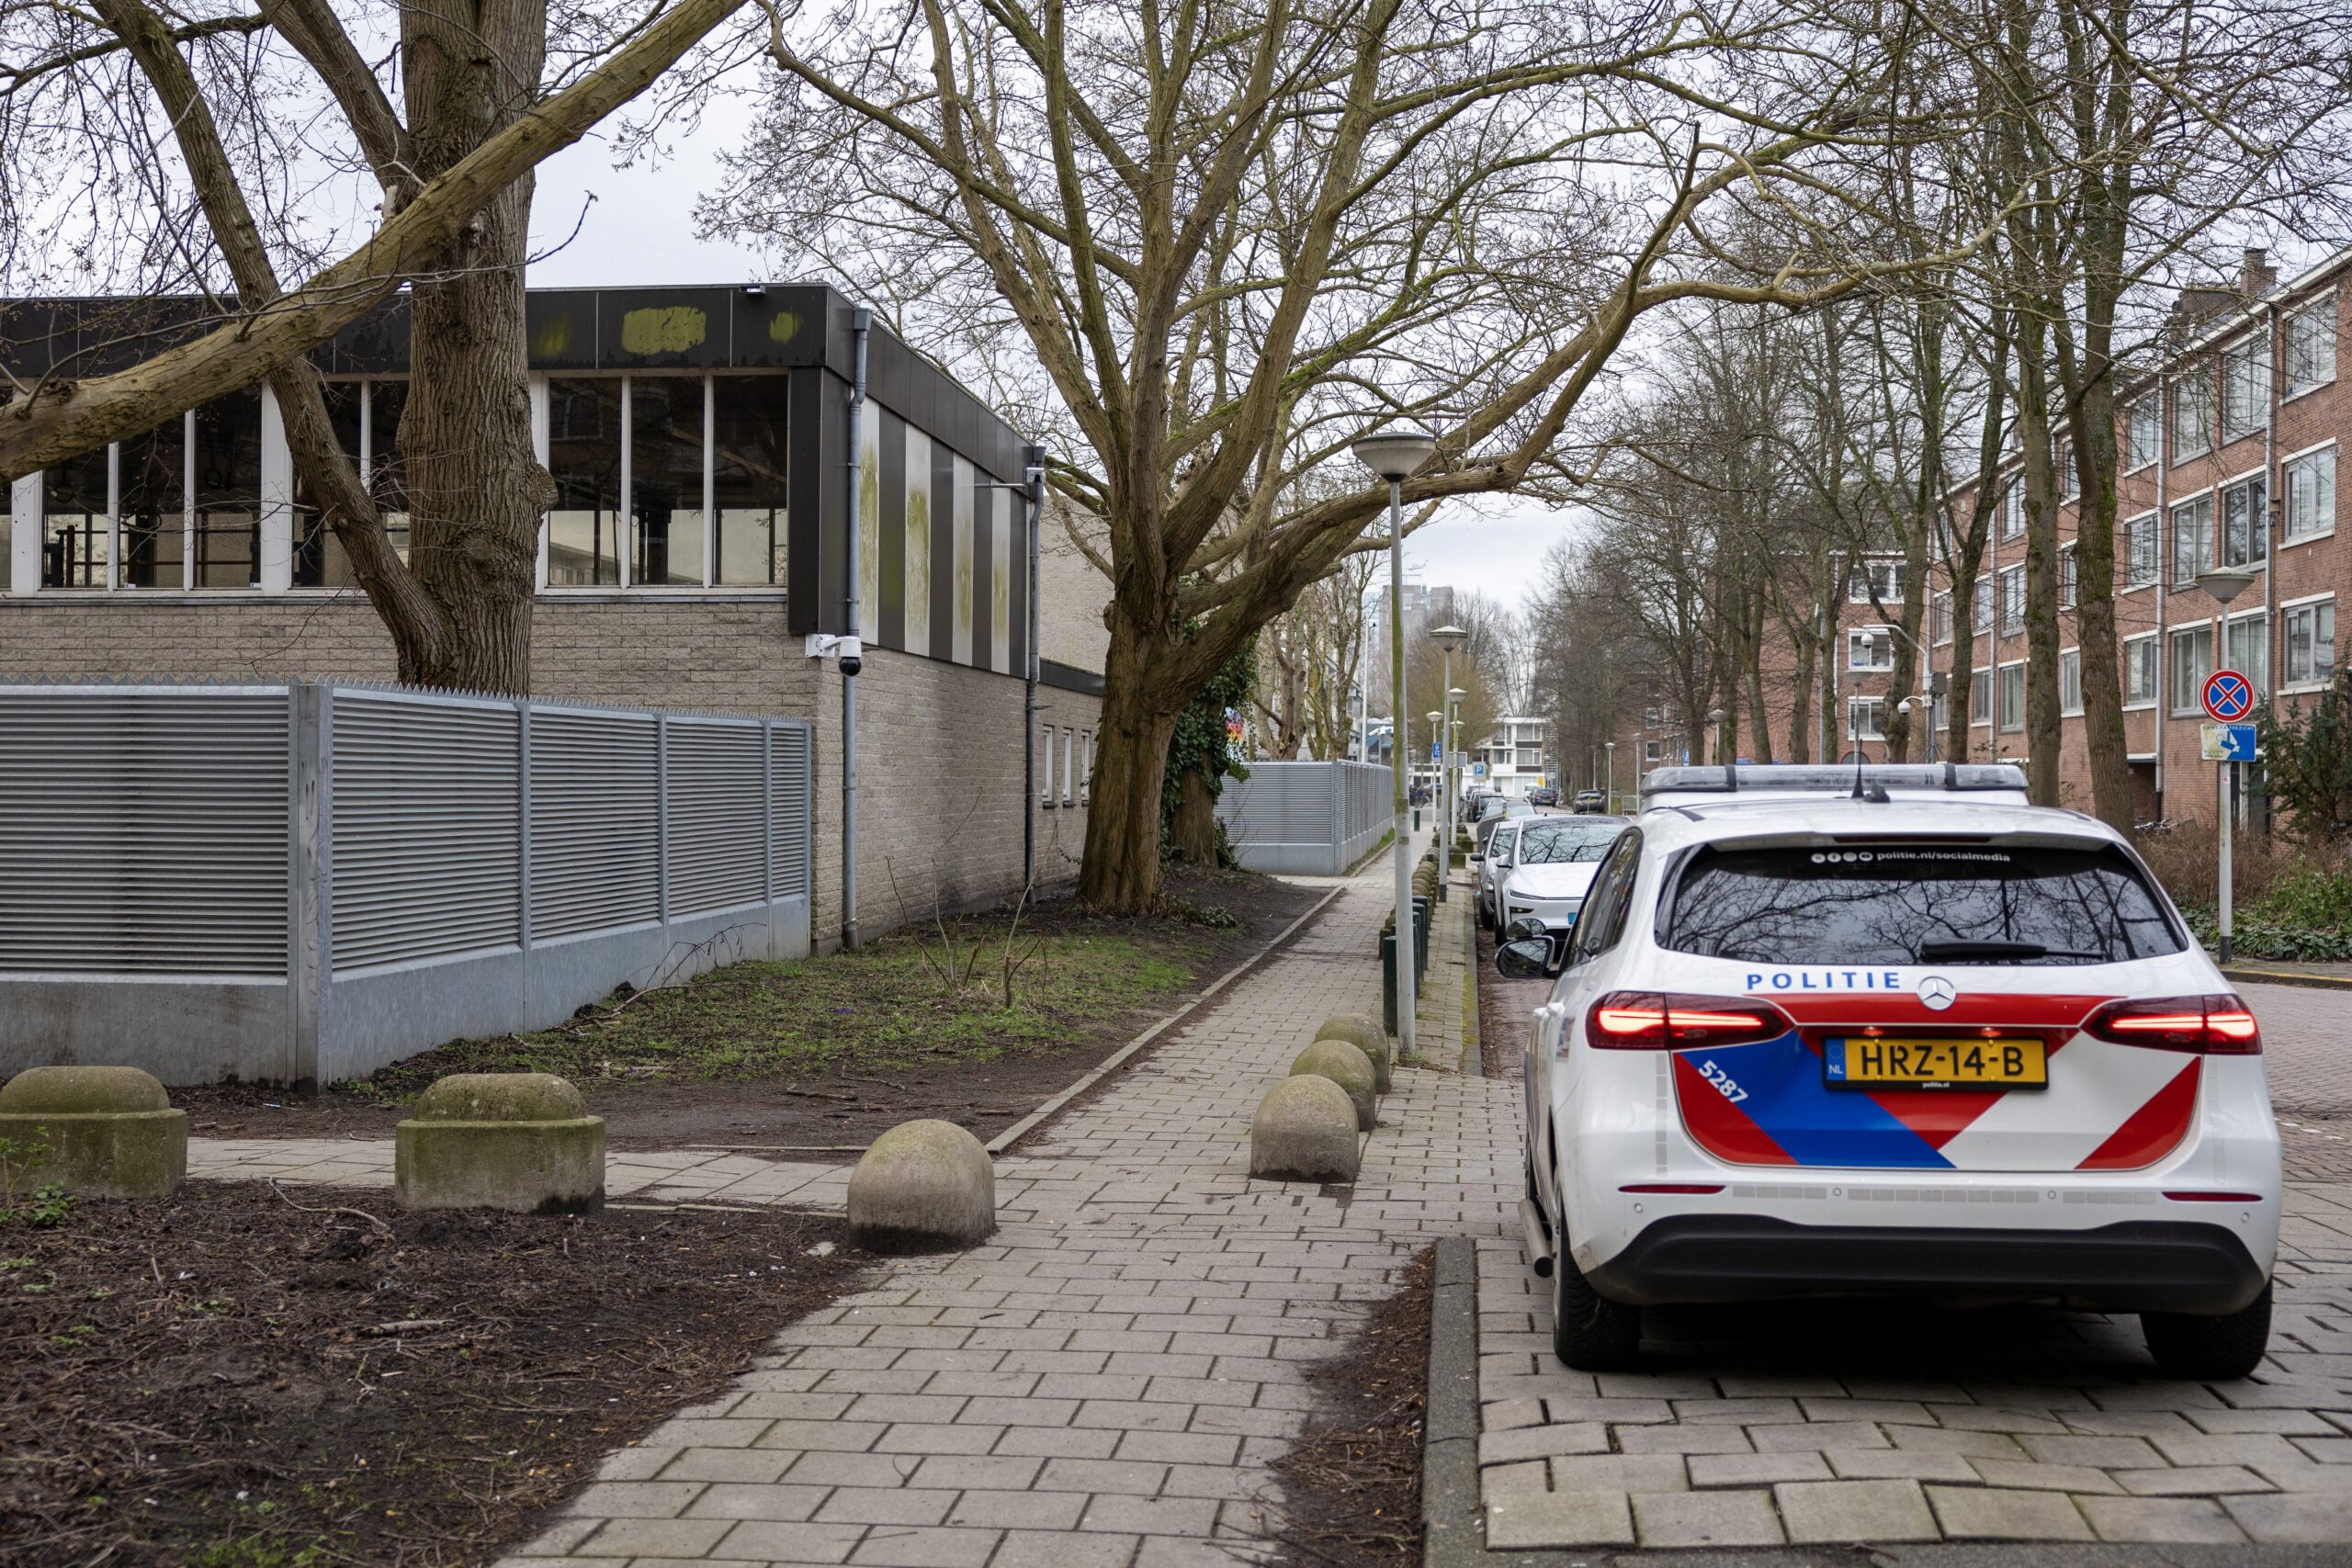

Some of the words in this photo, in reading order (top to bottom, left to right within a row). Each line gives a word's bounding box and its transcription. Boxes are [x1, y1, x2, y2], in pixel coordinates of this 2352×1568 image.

[1877, 852, 2010, 862] politie.nl/socialmedia
[1747, 972, 1900, 990] POLITIE
[1860, 1045, 2024, 1076] HRZ-14-B
[1828, 1066, 1844, 1075] NL
[1698, 1060, 1748, 1102] 5287
